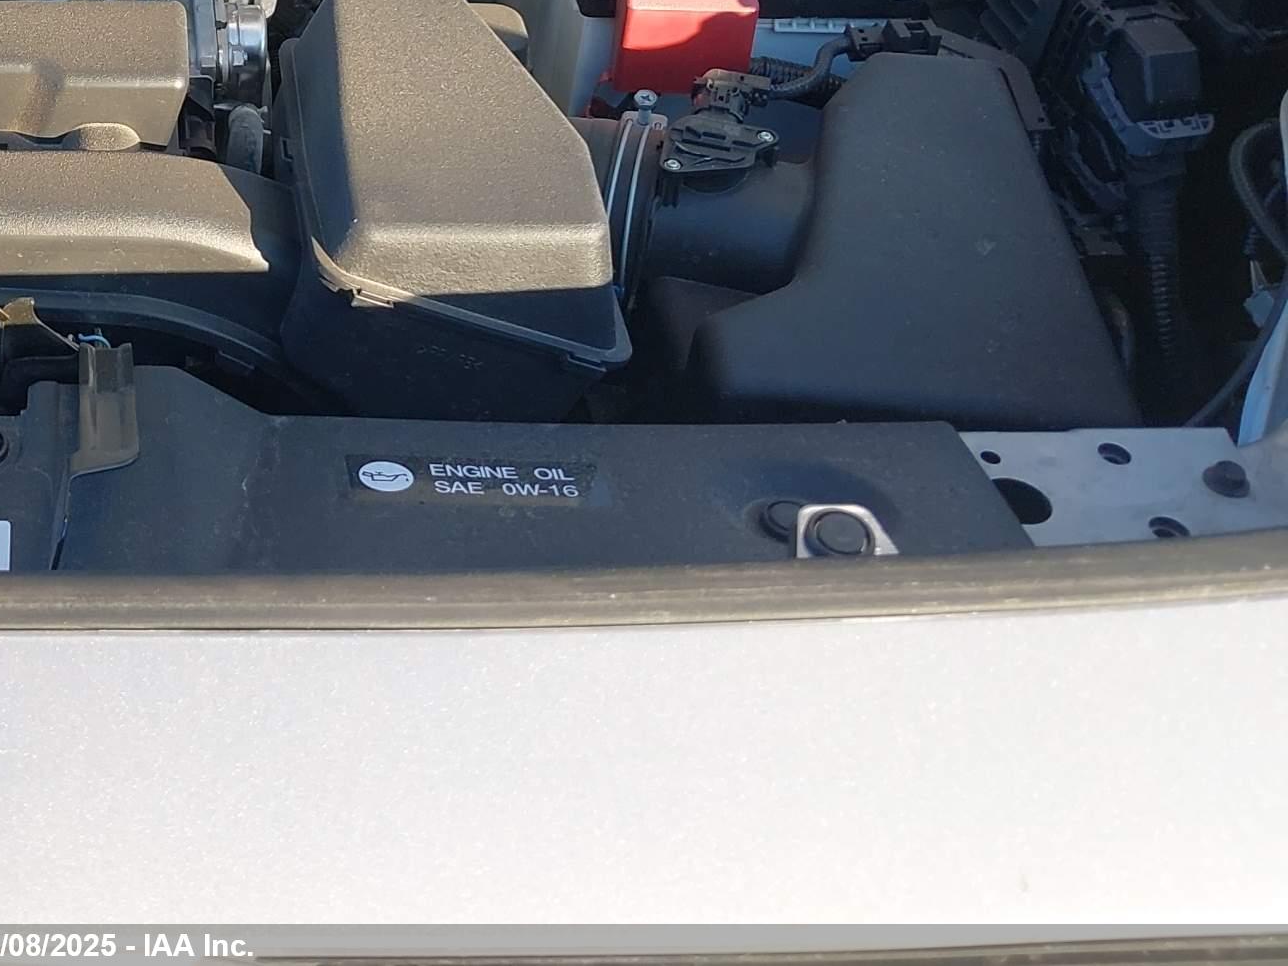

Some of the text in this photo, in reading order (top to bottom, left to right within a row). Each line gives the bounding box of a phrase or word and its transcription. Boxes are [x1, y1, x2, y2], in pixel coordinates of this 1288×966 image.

[428, 463, 576, 481] ENGINE OIL
[434, 480, 580, 498] SAE 0W-16
